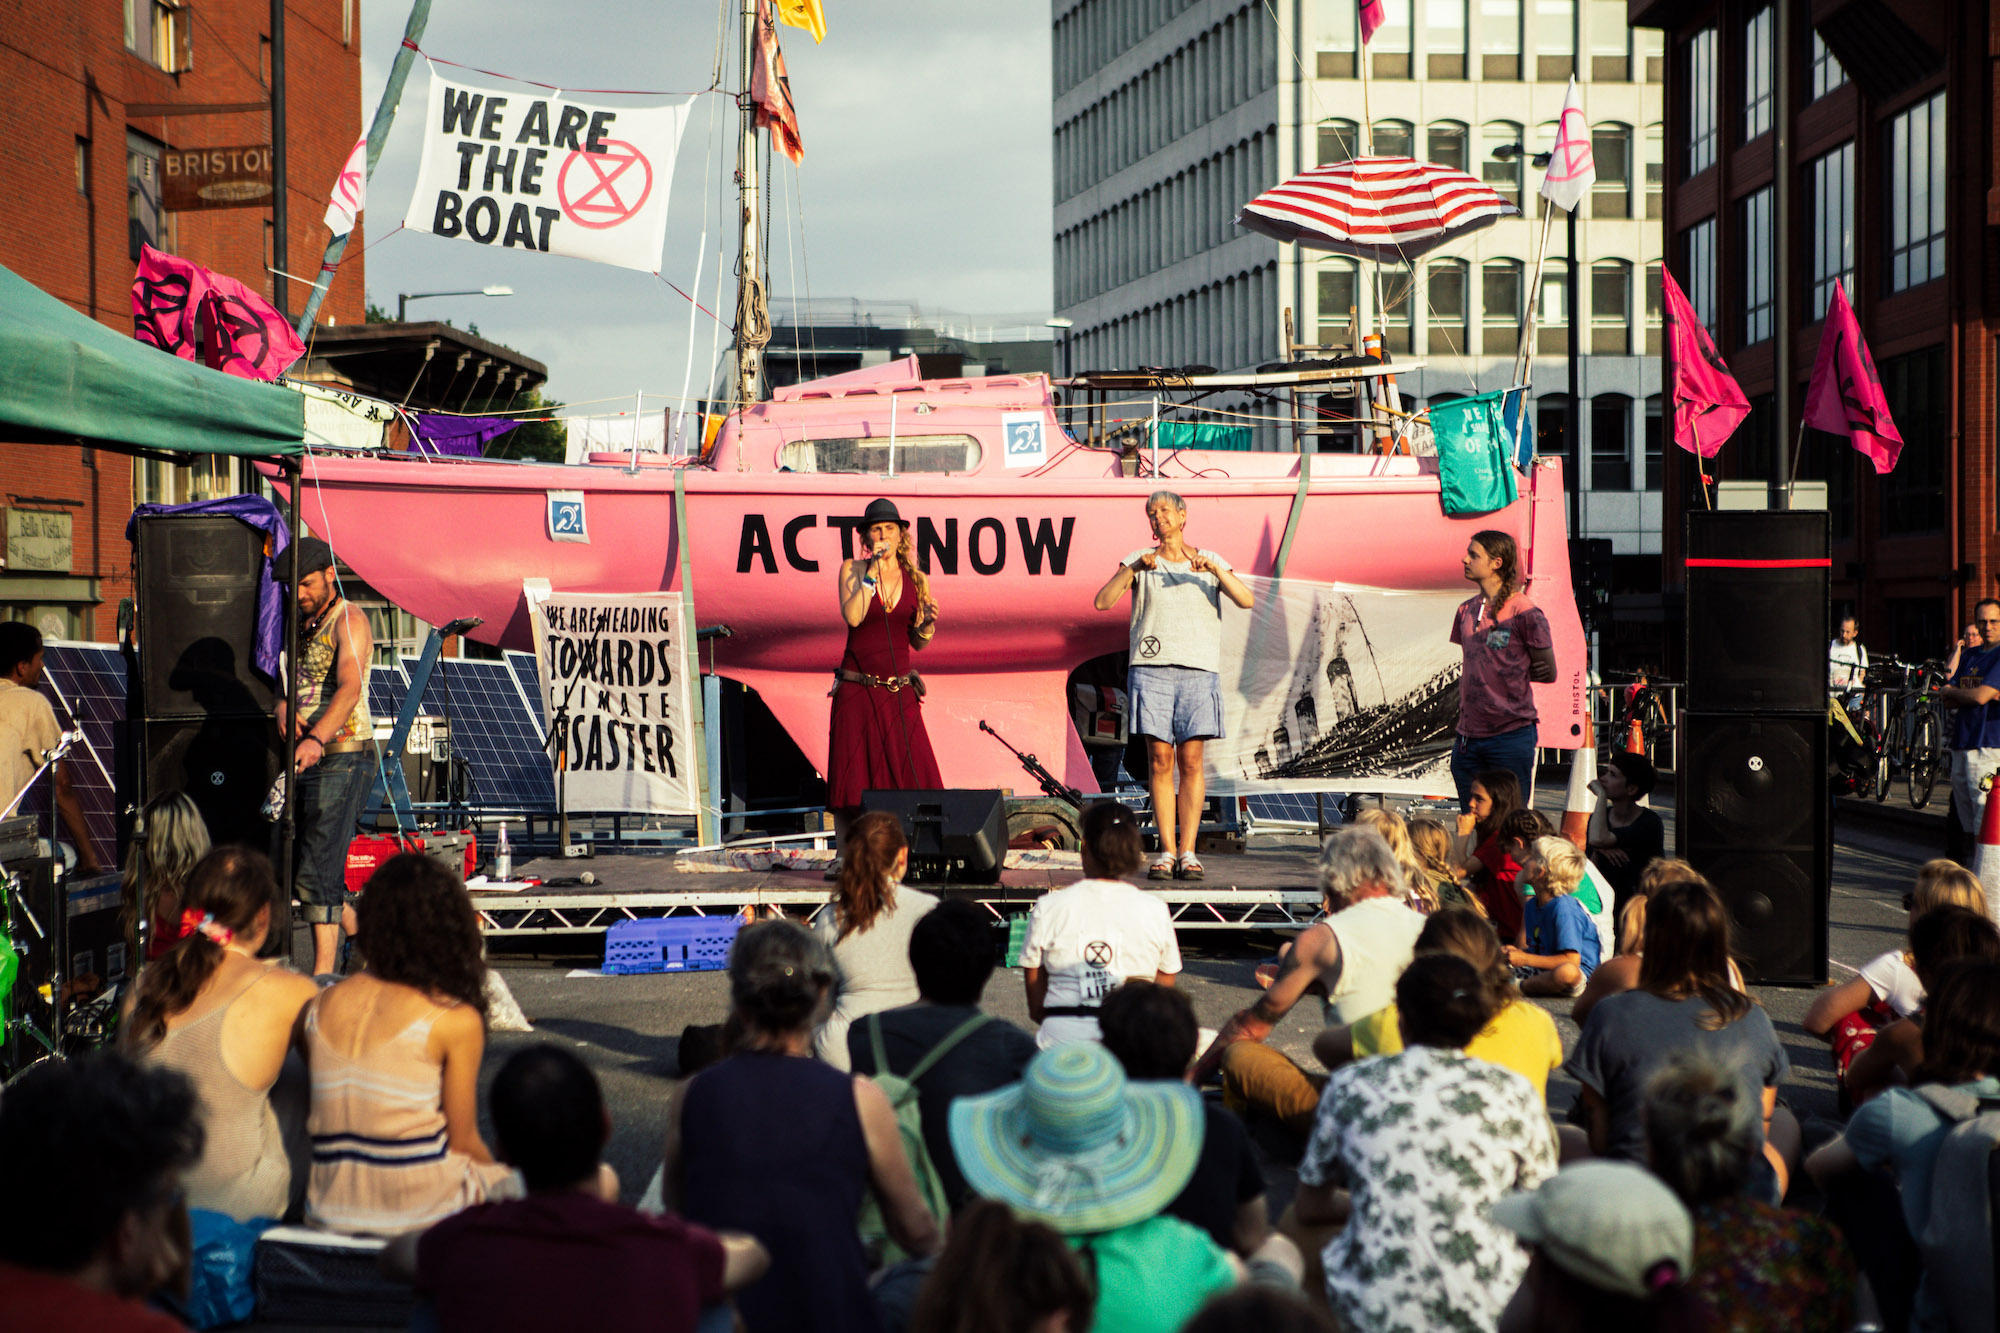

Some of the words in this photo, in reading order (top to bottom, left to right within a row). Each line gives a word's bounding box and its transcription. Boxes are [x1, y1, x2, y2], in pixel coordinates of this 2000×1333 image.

[442, 86, 508, 141] WE
[515, 101, 616, 155] ARE
[457, 141, 549, 195] THE
[432, 189, 561, 252] BOAT
[736, 514, 865, 575] ACT
[917, 516, 1076, 576] NOW
[546, 606, 566, 631] WE
[570, 607, 597, 632] ARE
[602, 607, 669, 633] HEADING
[548, 635, 672, 687] TOWARDS
